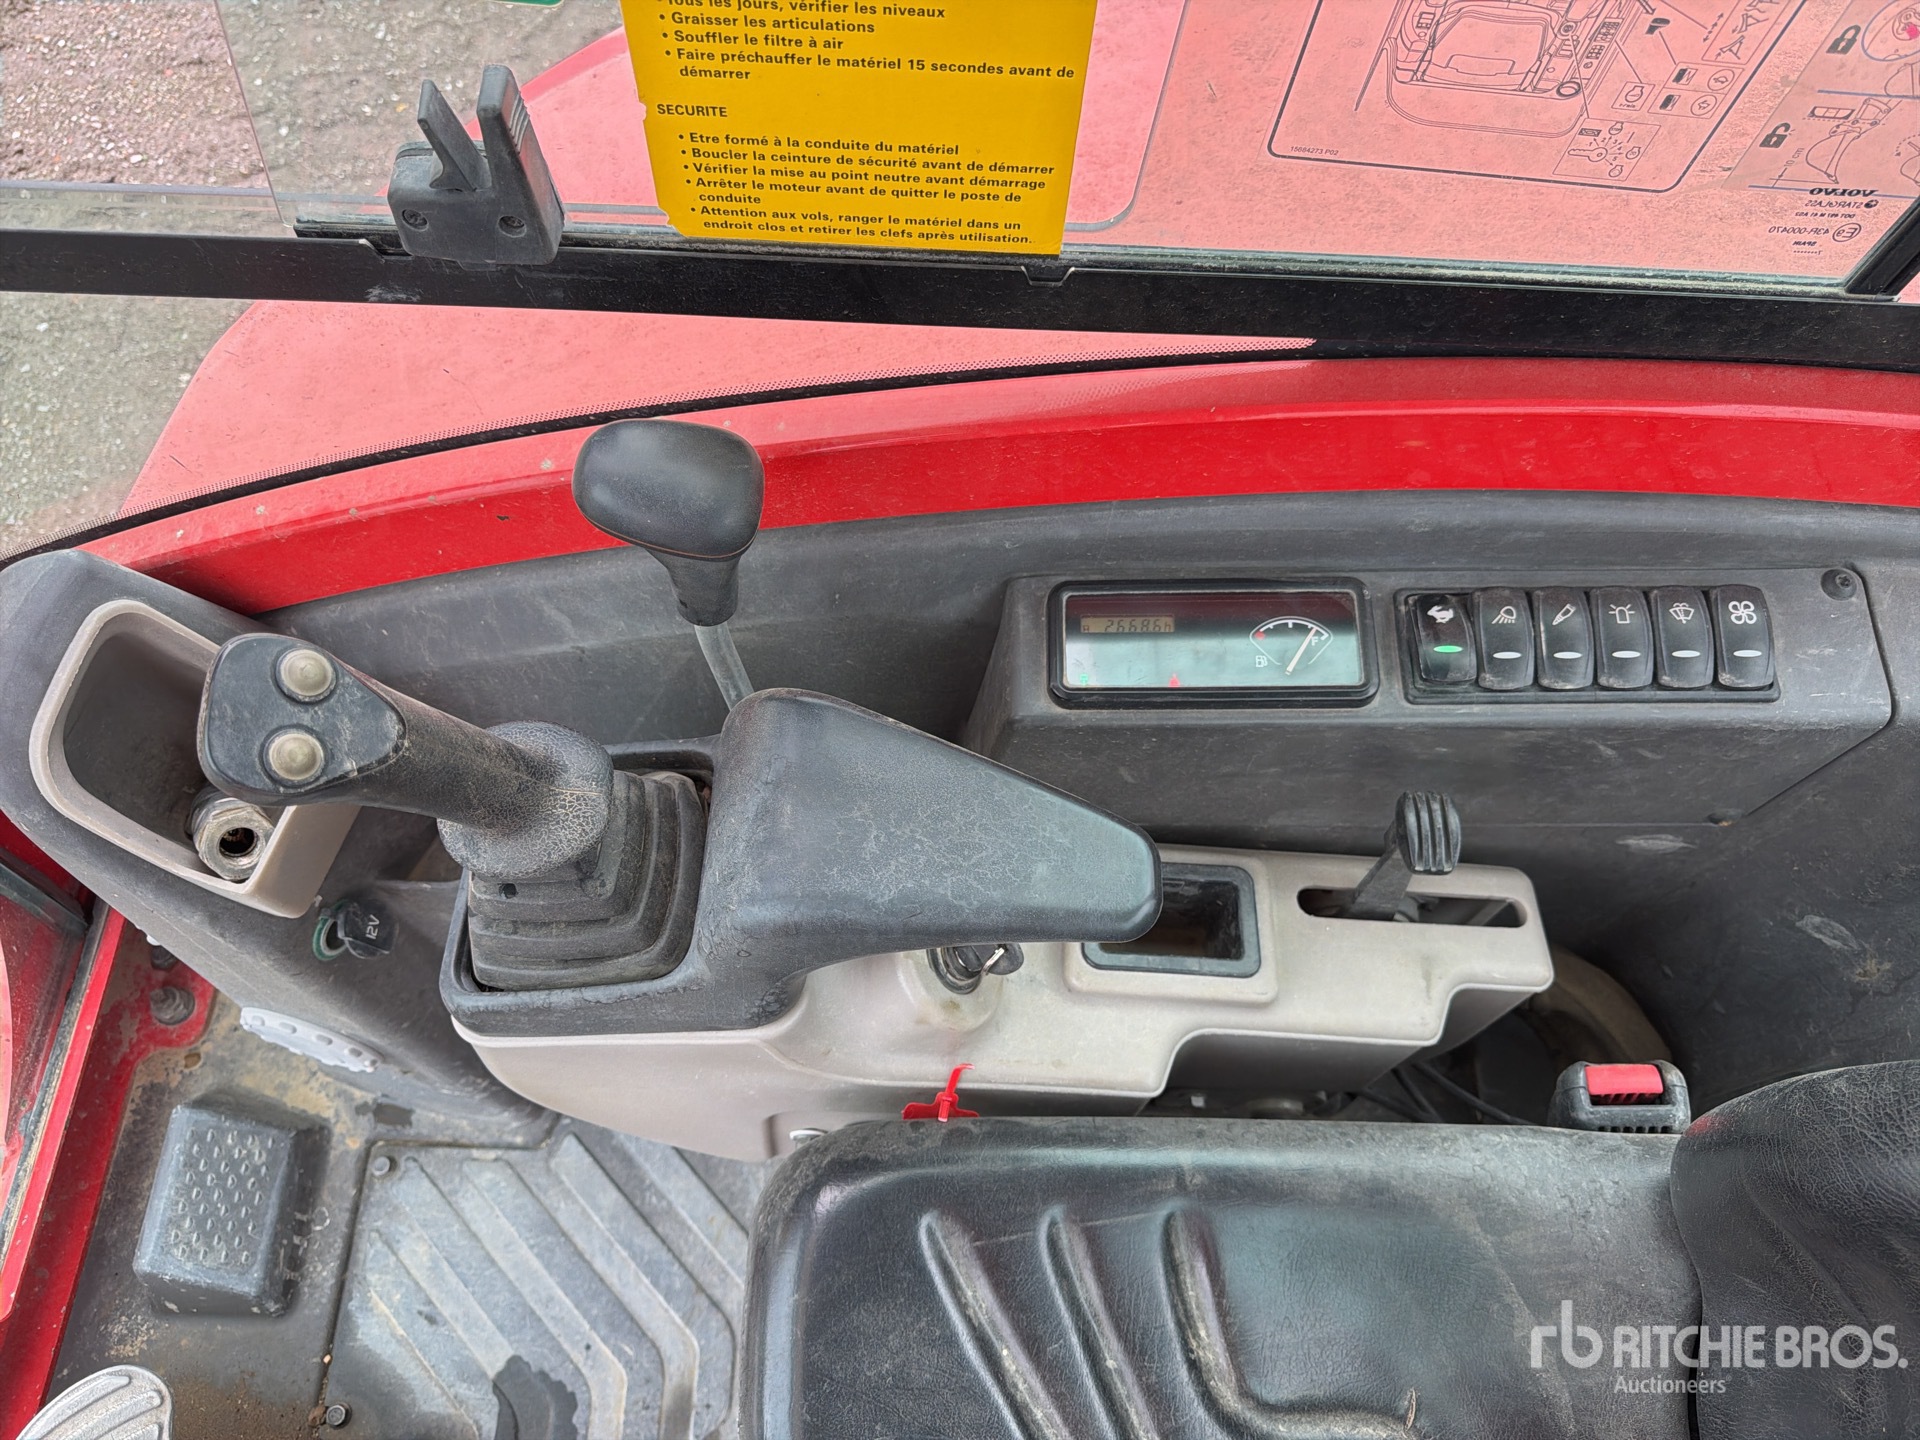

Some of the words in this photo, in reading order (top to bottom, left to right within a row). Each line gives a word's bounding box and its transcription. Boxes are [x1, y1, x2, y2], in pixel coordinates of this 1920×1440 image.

[709, 0, 731, 8] les
[737, 0, 783, 12] jours,
[789, 0, 849, 13] vérifier
[855, 2, 877, 14] les
[883, 3, 945, 18] niveaux
[672, 12, 738, 26] Graisser
[744, 15, 766, 28] les
[772, 17, 874, 33] articulations
[674, 30, 739, 44] Souffler
[744, 33, 758, 45] le
[763, 34, 803, 47] filtre
[809, 36, 817, 48] à
[823, 37, 843, 49] air
[677, 48, 715, 61] Faire
[721, 51, 812, 65] préchauffer
[818, 54, 831, 66] le
[837, 57, 901, 69] matériel
[908, 59, 925, 70] 15
[931, 62, 1003, 74] secondes
[1009, 67, 1052, 77] avant
[1057, 66, 1074, 78] de
[680, 66, 750, 79] démarrer
[657, 104, 727, 117] SECURITE
[689, 132, 719, 143] Etre
[724, 134, 768, 146] formé
[774, 136, 781, 146] à
[787, 137, 799, 147] la
[805, 139, 869, 150] conduite
[875, 141, 892, 152] du
[898, 144, 958, 155] matériel
[692, 148, 748, 160] Boucler
[753, 151, 765, 161] la
[771, 152, 831, 164] ceinture
[836, 155, 853, 165] de
[859, 156, 917, 168] sécurité
[922, 161, 961, 170] avant
[967, 161, 983, 171] de
[989, 162, 1054, 174] démarrer
[693, 163, 748, 174] Vérifier
[753, 165, 765, 175] la
[771, 167, 804, 177] mise
[832, 170, 869, 181] point
[874, 174, 920, 183] neutre
[925, 177, 964, 185] avant
[970, 176, 1045, 190] démarrage
[696, 178, 747, 189] Arrêter
[752, 180, 764, 190] le
[769, 183, 821, 192] moteur
[826, 186, 864, 195] avant
[870, 186, 886, 196] de
[891, 188, 939, 198] quitter
[944, 189, 956, 199] le
[961, 193, 1000, 202] poste
[1005, 192, 1021, 202] de
[699, 193, 761, 204] conduite
[701, 206, 766, 217] Attention
[801, 211, 833, 222] vols,
[839, 215, 883, 225] ranger
[888, 215, 900, 224] le
[905, 217, 962, 227] matériel
[967, 219, 999, 229] dans
[704, 220, 753, 230] endroit
[758, 222, 785, 231] clos
[790, 225, 803, 233] et
[809, 225, 851, 235] retirer
[857, 227, 875, 236] les
[880, 228, 913, 238] clefs
[918, 231, 954, 241] après
[960, 233, 1031, 243] utilisation.
[1311, 636, 1318, 646] F
[365, 914, 380, 939] 12V
